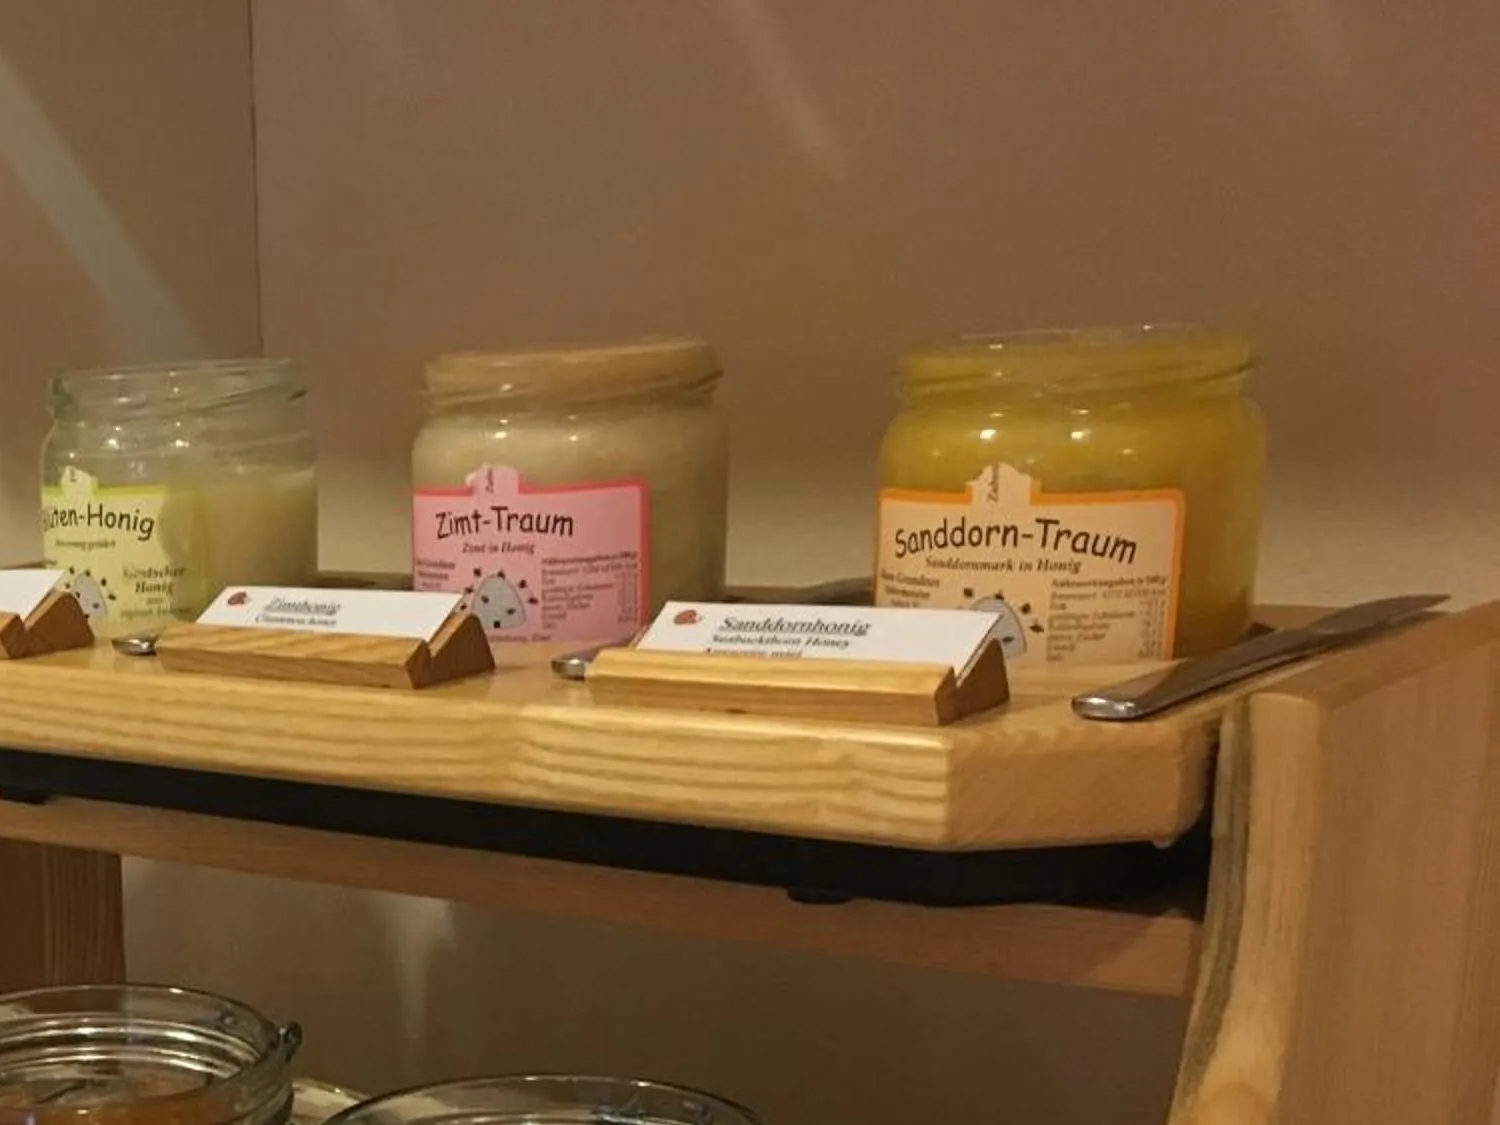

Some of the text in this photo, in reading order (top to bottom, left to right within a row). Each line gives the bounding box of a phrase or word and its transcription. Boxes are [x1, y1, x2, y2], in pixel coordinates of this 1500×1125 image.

[435, 505, 574, 540] Zimt-Traum
[894, 516, 1138, 565] Sanddorn-Traum
[925, 554, 1083, 574] Sanddornmark in Honig
[718, 616, 872, 638] Sanddornhonig
